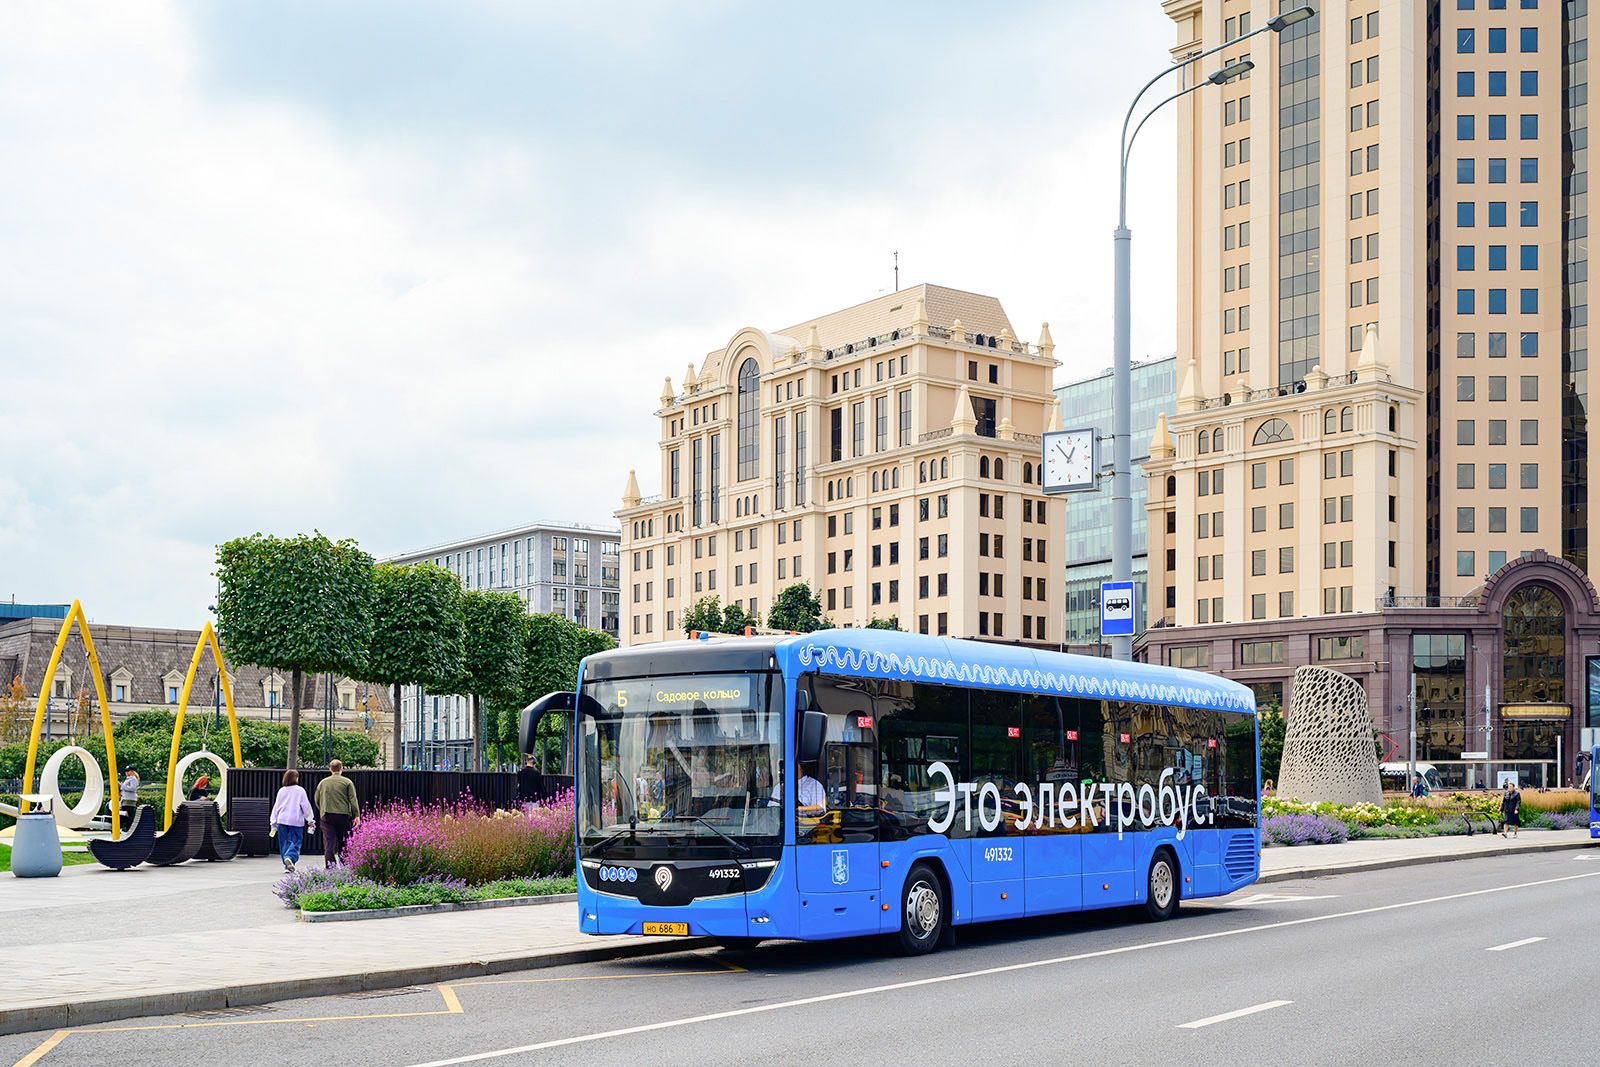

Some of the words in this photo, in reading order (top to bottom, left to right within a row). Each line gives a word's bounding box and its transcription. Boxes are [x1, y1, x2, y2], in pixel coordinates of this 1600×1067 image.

[617, 690, 628, 707] Б
[656, 690, 700, 703] Садовое
[703, 689, 741, 700] кольцо
[927, 761, 1001, 833] Это
[1013, 767, 1214, 840] электробус.
[984, 847, 1013, 861] 491332
[709, 869, 740, 878] 491332
[659, 924, 673, 933] 686
